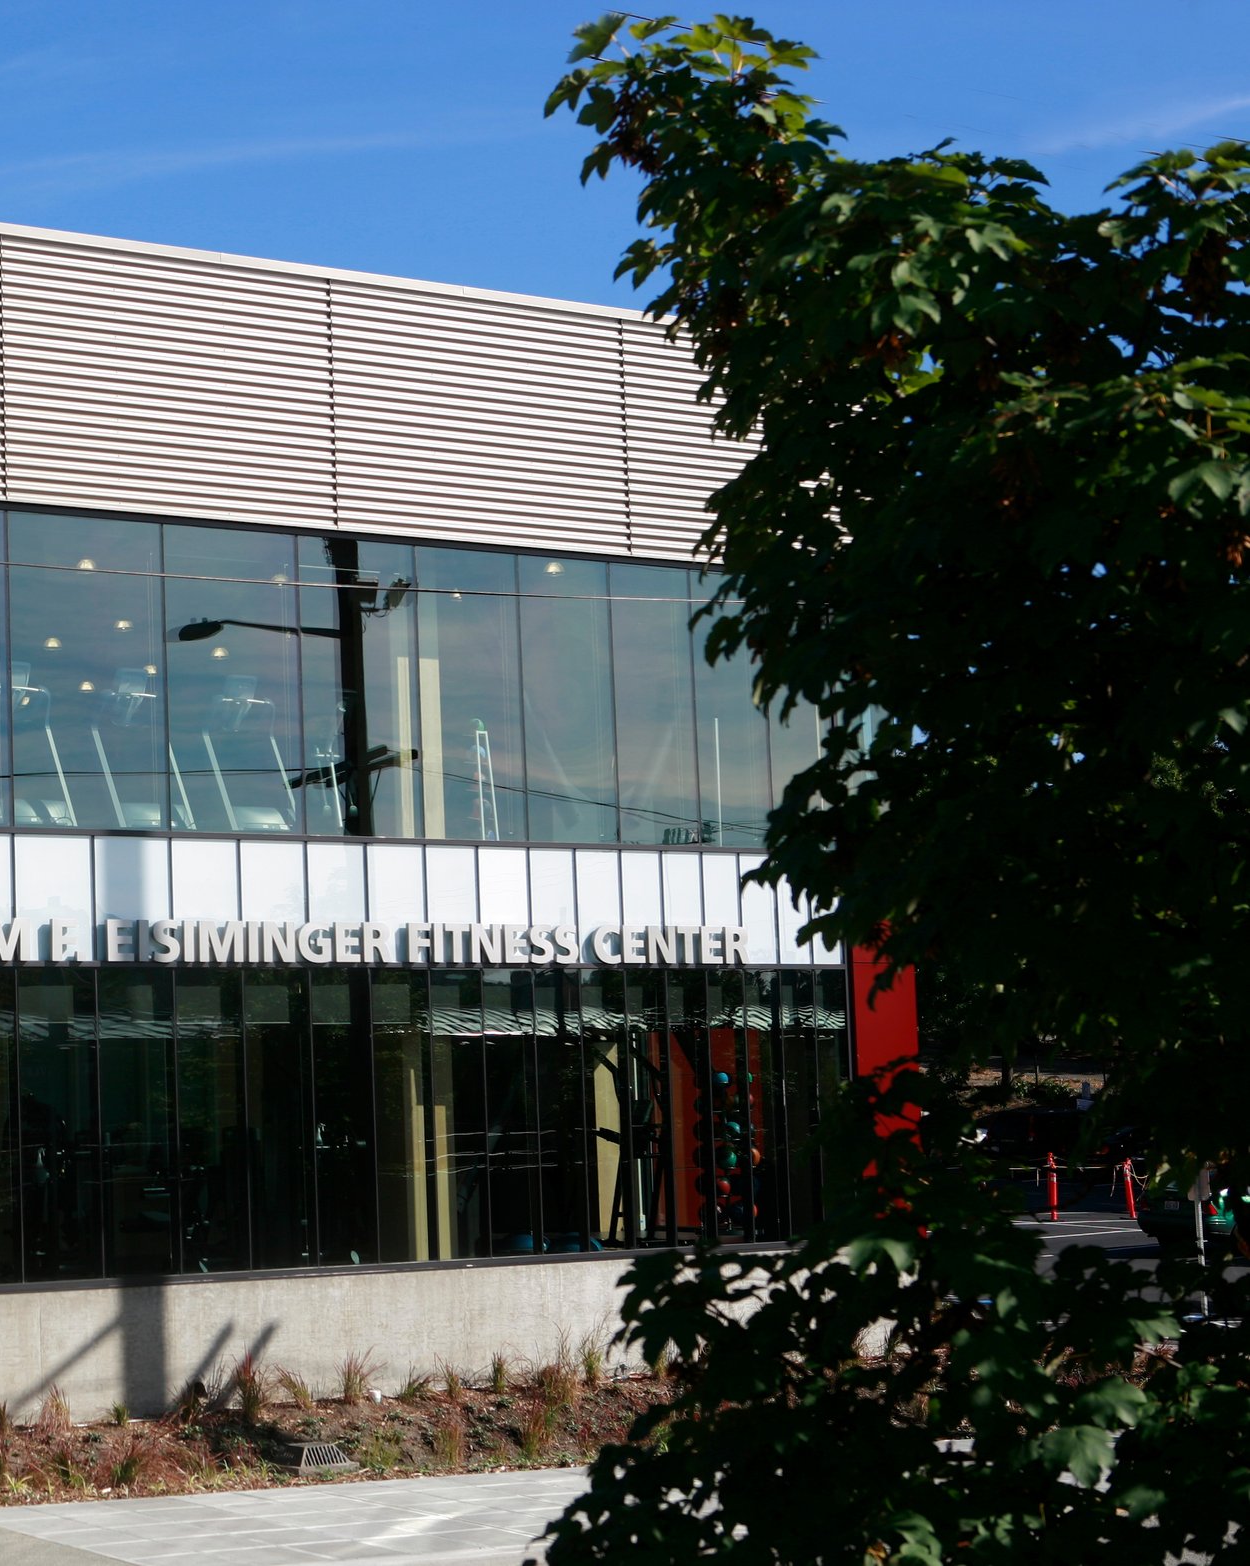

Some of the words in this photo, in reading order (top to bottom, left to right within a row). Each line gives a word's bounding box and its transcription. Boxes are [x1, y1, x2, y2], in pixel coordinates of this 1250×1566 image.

[106, 918, 390, 964] EISIMINGER
[405, 922, 579, 965] FITNESS
[592, 924, 750, 966] CENTER
